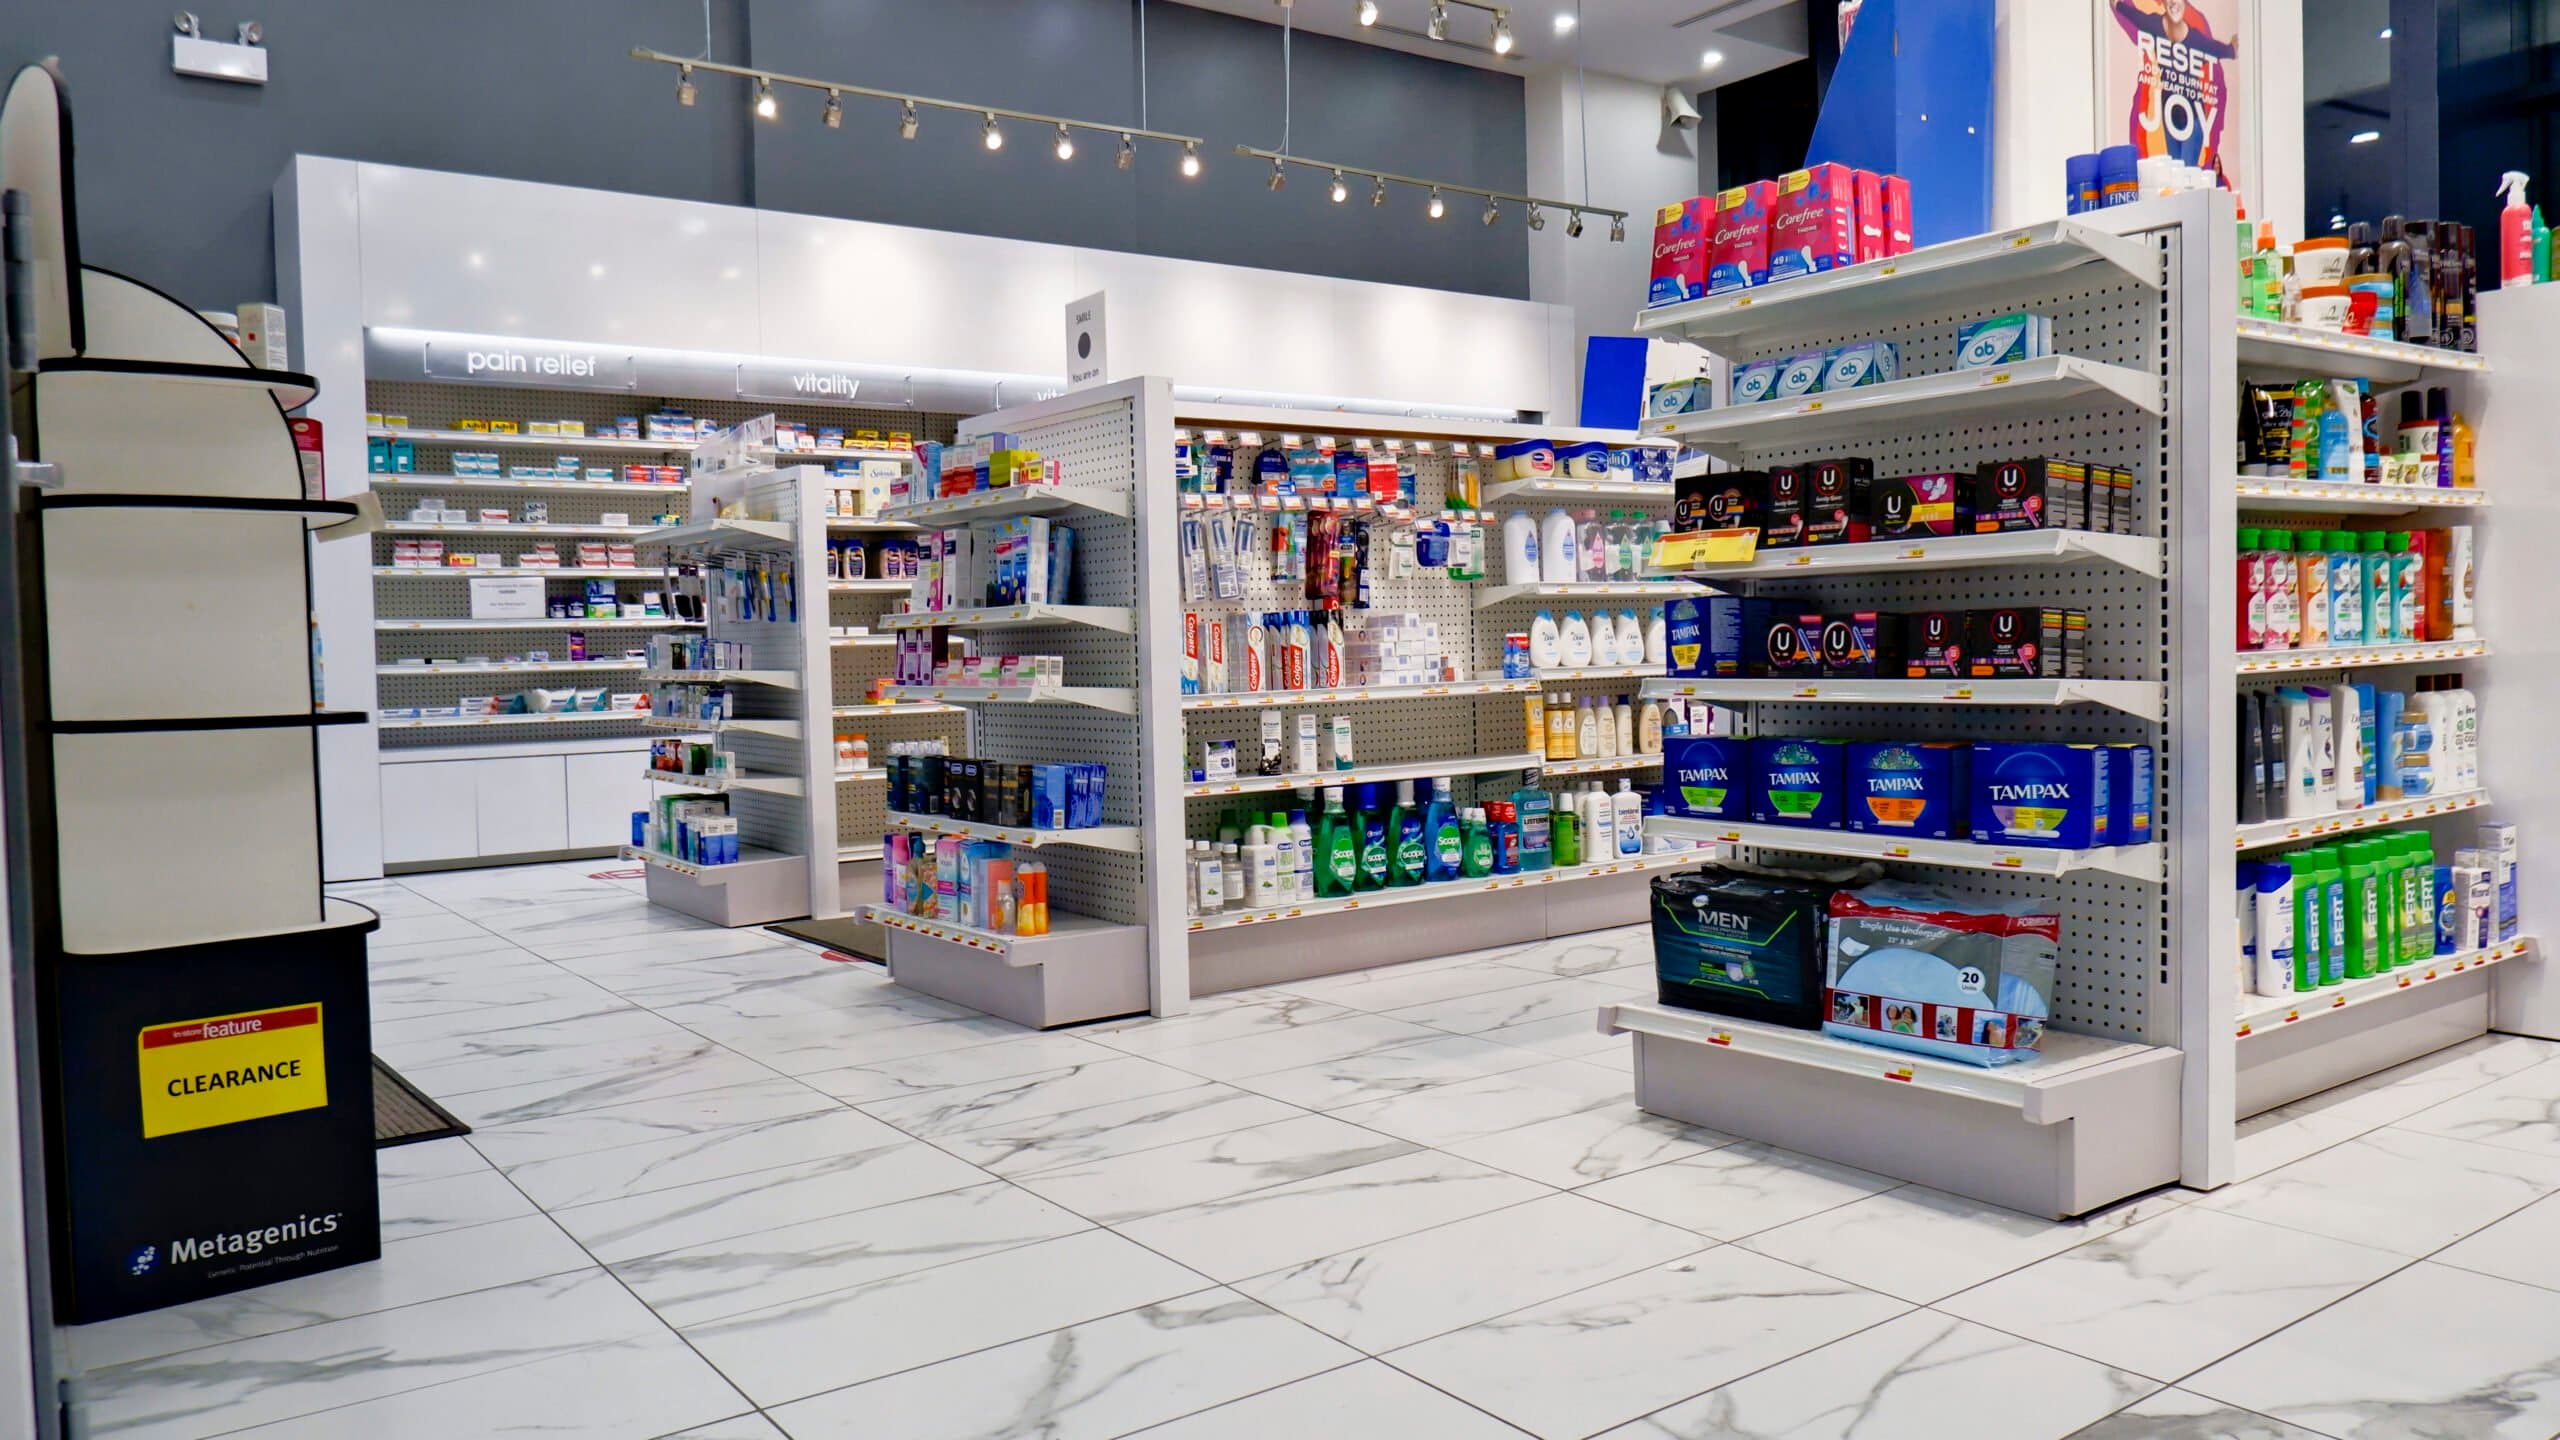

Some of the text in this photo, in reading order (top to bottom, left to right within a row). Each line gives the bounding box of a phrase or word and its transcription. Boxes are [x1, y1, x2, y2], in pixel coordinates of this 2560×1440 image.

[2137, 30, 2218, 81] RESET
[2165, 69, 2177, 82] TO
[2179, 73, 2201, 89] BURN
[2204, 81, 2217, 95] FAT
[2138, 88, 2218, 148] JOY
[1776, 207, 1824, 229] Carefree
[1715, 224, 1760, 245] Carefree
[1655, 238, 1696, 259] Carefree
[1773, 256, 1785, 265] 49
[1712, 269, 1722, 279] 49
[468, 351, 596, 377] pain relief
[793, 372, 860, 399] vitality
[1781, 474, 1792, 490] U
[1823, 469, 1835, 486] U
[2003, 468, 2018, 487] U
[1679, 504, 1687, 516] U
[1714, 499, 1723, 511] U
[1887, 495, 1902, 514] U
[1671, 623, 1700, 641] TAMPAX
[1930, 619, 1941, 635] U
[1999, 615, 2013, 633] U
[1187, 616, 1195, 656] Colgate
[1777, 631, 1790, 651] U
[1832, 630, 1845, 650] U
[1293, 649, 1302, 687] Colgate
[1329, 650, 1337, 687] Colgate
[1678, 767, 1728, 782] TAMPAX
[1768, 771, 1820, 786] TAMPAX
[1867, 776, 1924, 792] TAMPAX
[1988, 783, 2070, 801] TAMPAX
[2405, 880, 2416, 928] PERT
[2421, 877, 2433, 925] PERT
[1698, 909, 1749, 931] MEN
[2333, 895, 2344, 946] PERT
[2368, 889, 2378, 939] PERT
[1860, 920, 1883, 932] Single
[1885, 923, 1900, 932] Use
[2310, 901, 2319, 951] PERT
[1962, 972, 1979, 983] 20
[203, 1018, 262, 1039] feature
[167, 1059, 302, 1097] CLEARANCE
[170, 1212, 337, 1265] Metagenics
[274, 1251, 305, 1264] Through
[306, 1245, 339, 1257] Nutrition
